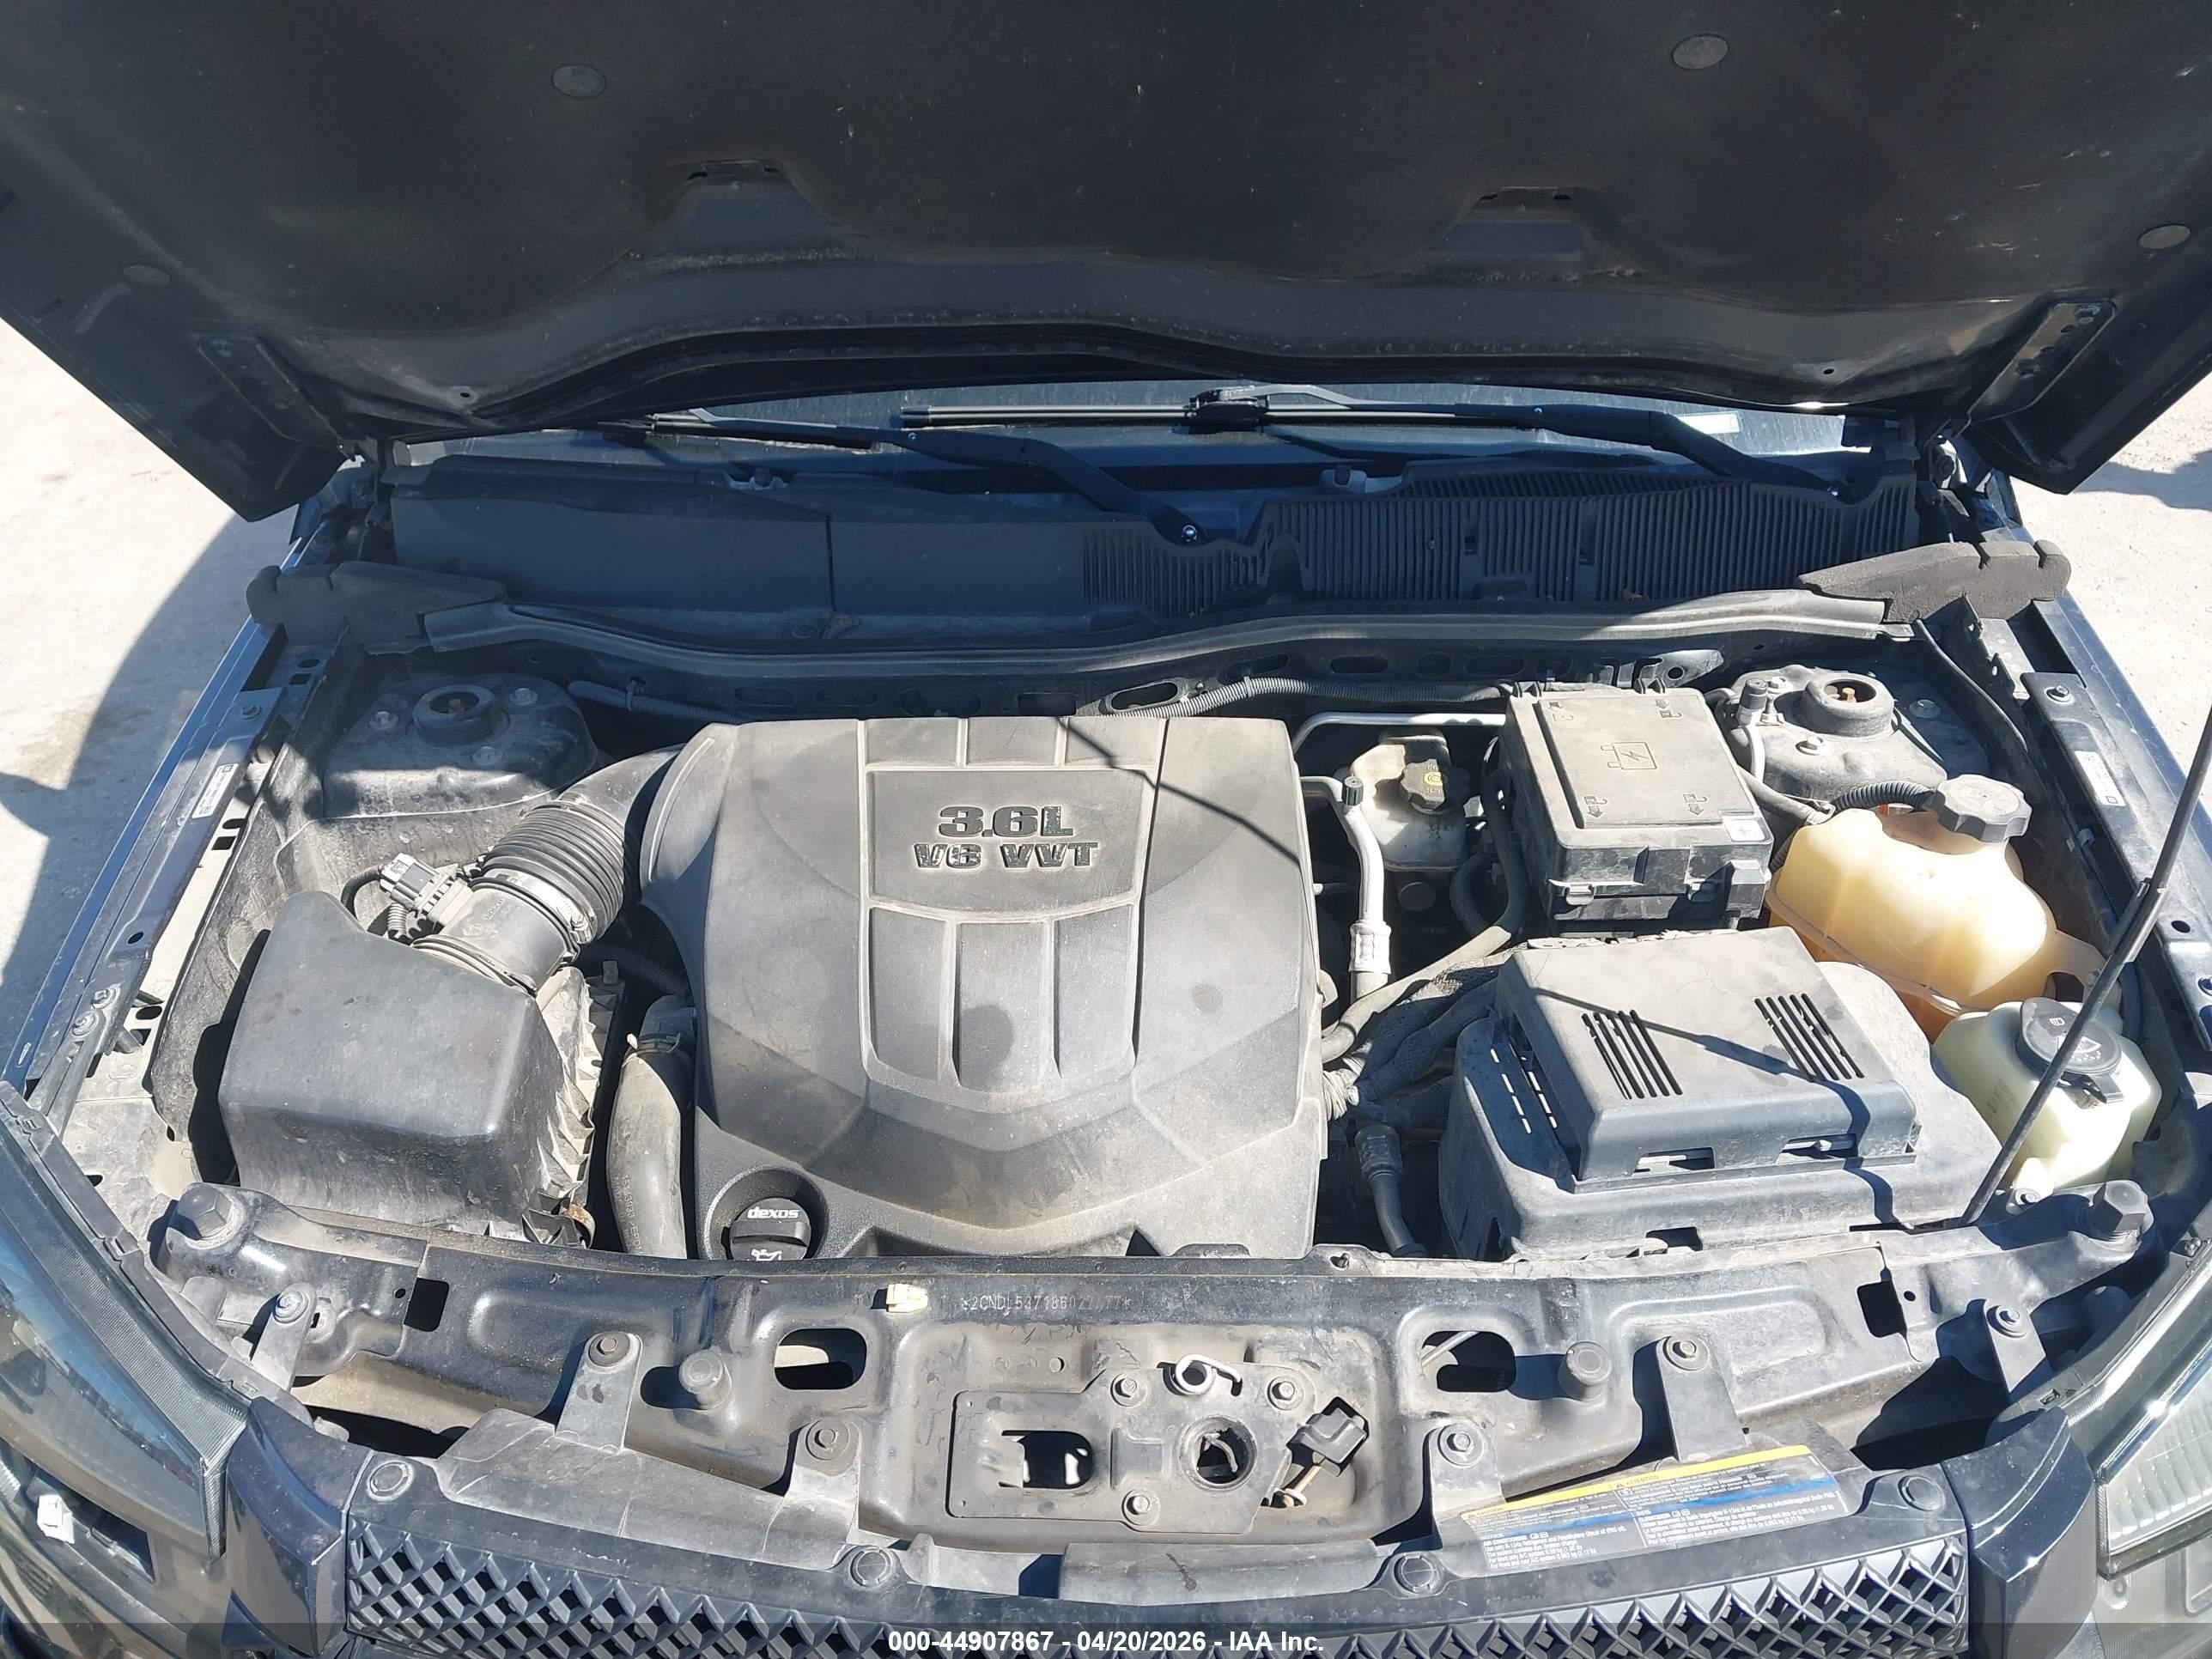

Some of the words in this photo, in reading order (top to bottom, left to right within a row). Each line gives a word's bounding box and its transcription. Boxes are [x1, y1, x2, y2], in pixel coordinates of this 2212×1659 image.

[939, 805, 1074, 838] 3.6L
[913, 842, 982, 869] V6
[1000, 842, 1099, 868] VVT
[747, 1206, 801, 1219] dexos
